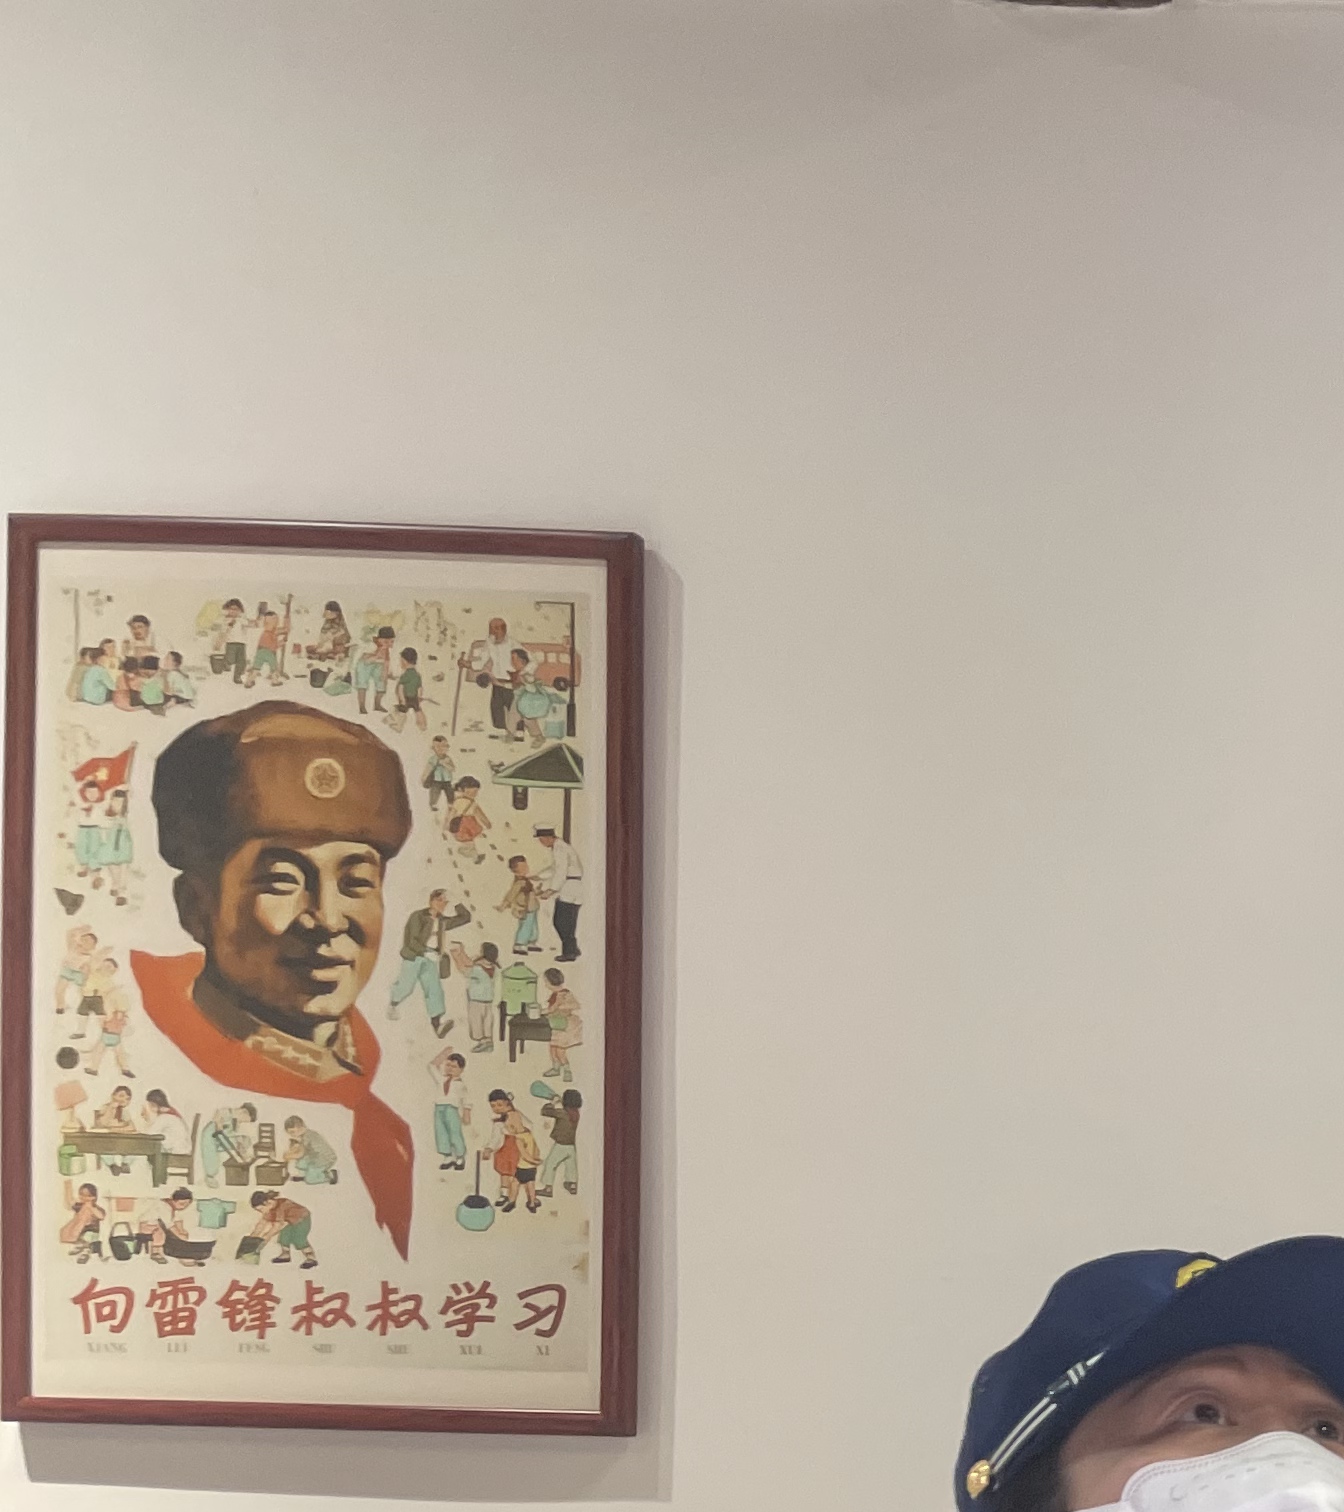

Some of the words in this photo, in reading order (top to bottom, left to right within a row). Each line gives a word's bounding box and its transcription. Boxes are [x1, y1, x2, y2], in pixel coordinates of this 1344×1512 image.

[70, 1276, 568, 1339] 向雷锋叔叔学习
